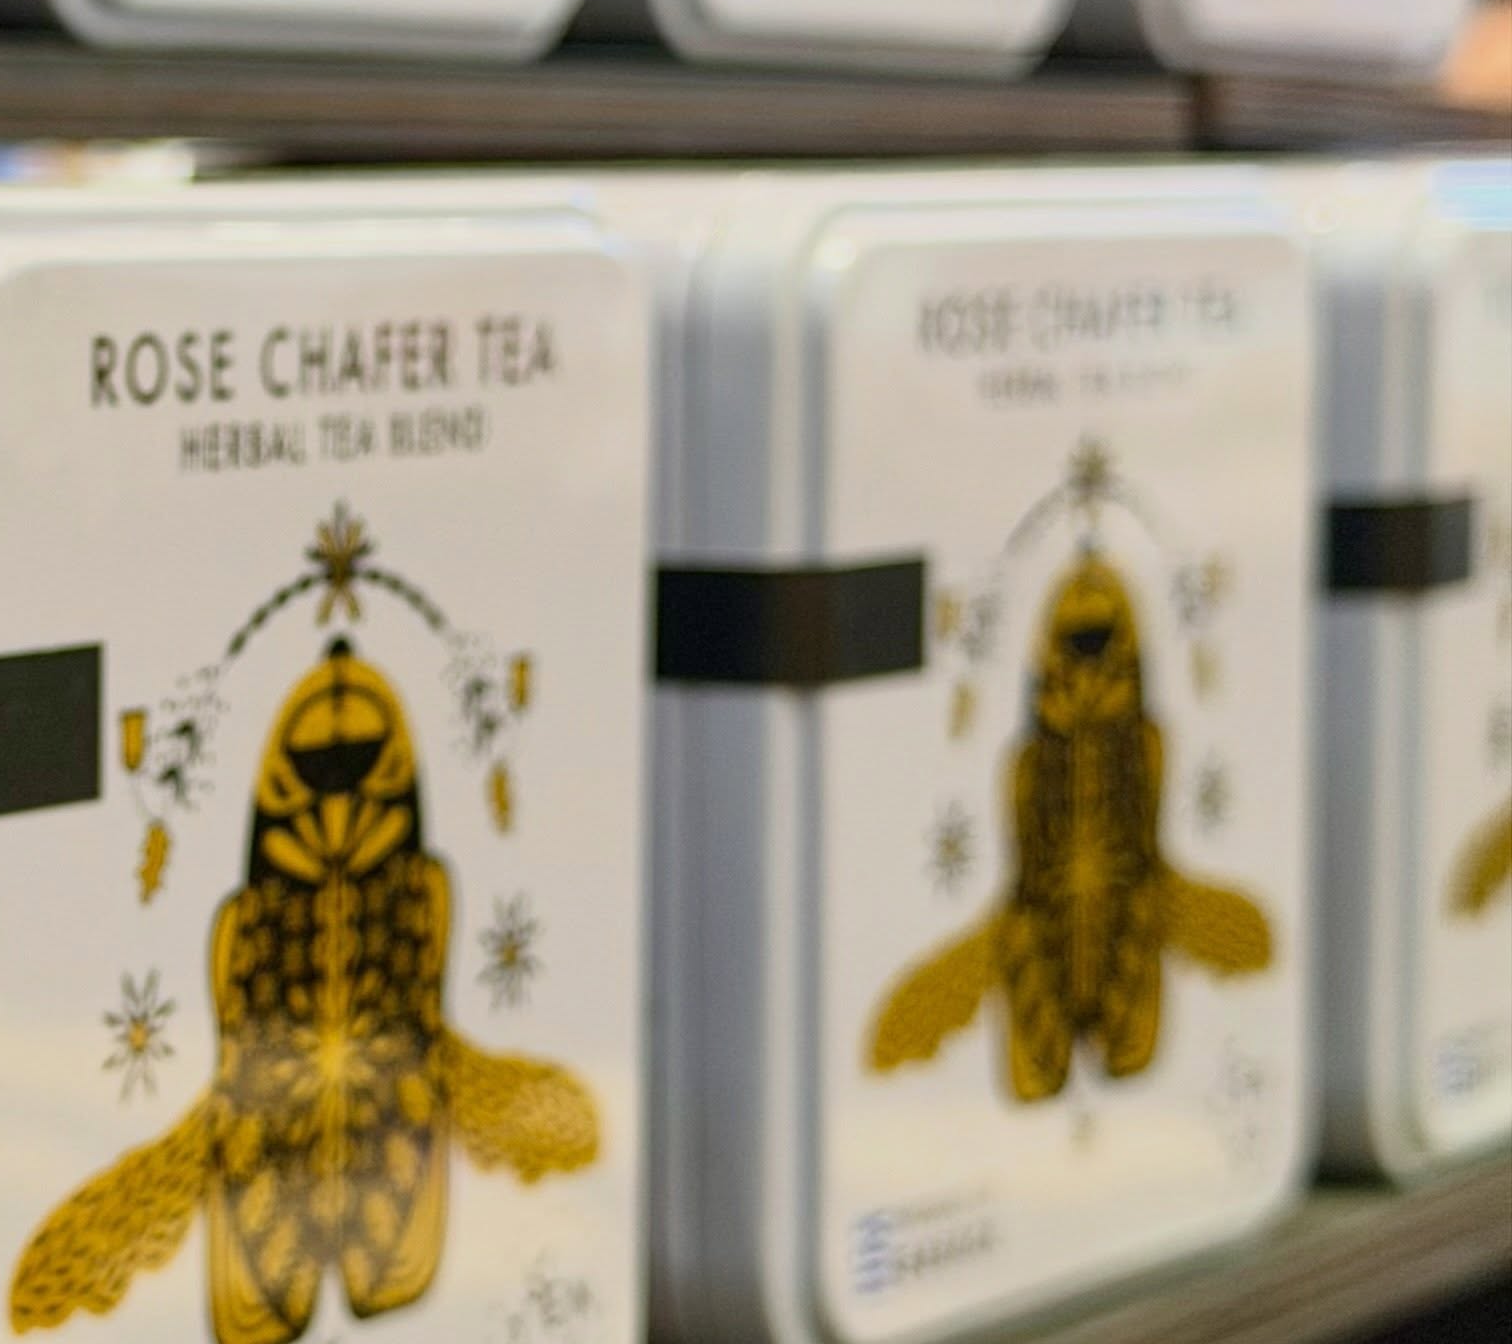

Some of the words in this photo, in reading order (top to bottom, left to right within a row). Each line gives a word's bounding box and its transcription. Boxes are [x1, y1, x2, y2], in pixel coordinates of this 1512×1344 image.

[91, 331, 235, 407] ROSE
[258, 320, 452, 399] CHAFER
[476, 314, 558, 385] TEA
